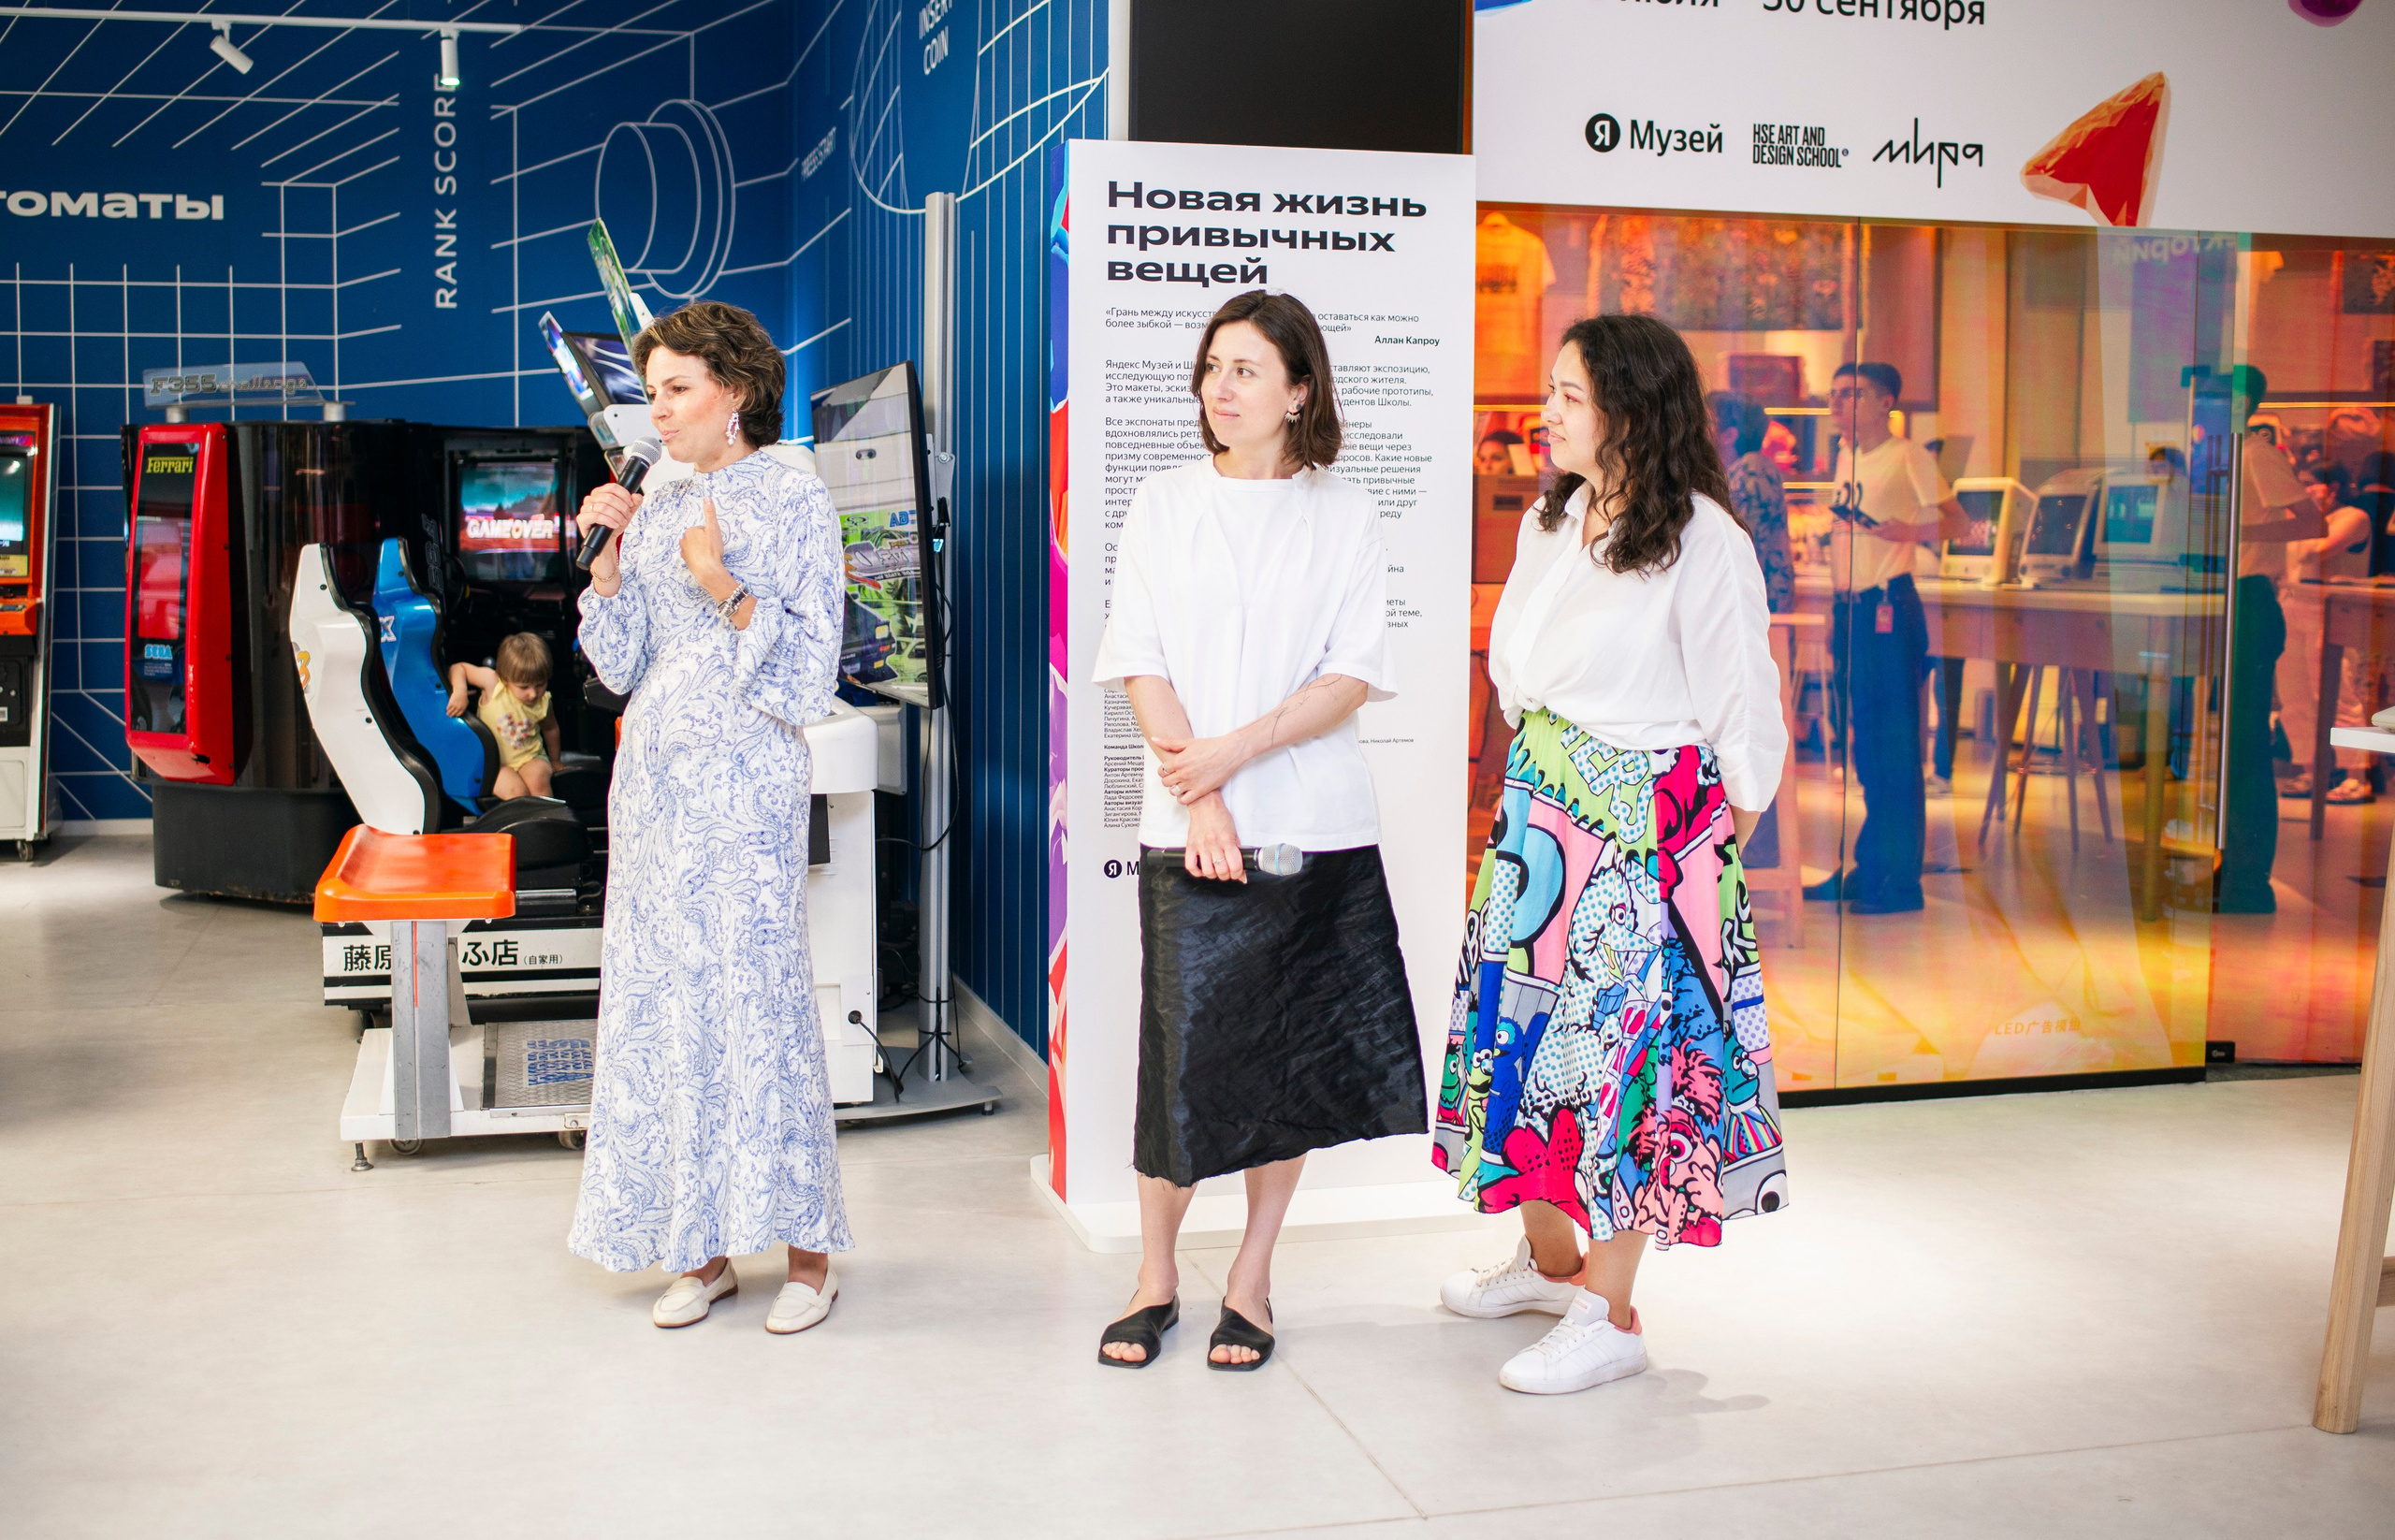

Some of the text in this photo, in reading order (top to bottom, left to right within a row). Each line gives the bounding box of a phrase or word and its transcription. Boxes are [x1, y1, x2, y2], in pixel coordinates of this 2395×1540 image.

[923, 25, 949, 75] COIN
[1630, 119, 1723, 157] Музей
[1753, 123, 1824, 147] HSE ART AND
[1753, 144, 1842, 168] DESIGN SCHOOL
[1108, 181, 1427, 217] Новая жизнь
[1108, 225, 1395, 253] привычных
[435, 209, 457, 309] RANK
[1108, 257, 1268, 288] вещей
[1106, 307, 1139, 318] «Грань
[1141, 309, 1173, 320] между
[1317, 312, 1369, 322] оставаться
[1387, 314, 1419, 323] можно
[1105, 319, 1135, 328] более
[1137, 318, 1172, 330] зыбкой
[1374, 336, 1440, 346] Аллан Капроу
[1106, 360, 1139, 370] Яндекс
[1142, 359, 1173, 370] Музей
[1372, 365, 1430, 374] экспозицию,
[149, 373, 217, 396] F355
[1106, 372, 1175, 382] исследующую
[1371, 376, 1406, 385] жителя.
[1106, 383, 1123, 391] Это
[1125, 385, 1163, 393] макеты,
[1342, 386, 1380, 396] рабочие
[1383, 387, 1433, 397] прототипы,
[1377, 398, 1412, 406] Школы.
[1106, 417, 1123, 426] Все
[1125, 419, 1175, 428] экспонаты
[1343, 432, 1403, 441] исследовали
[1105, 442, 1175, 450] повседневные
[146, 456, 194, 474] Ferrari
[1105, 454, 1142, 462] призму
[1374, 454, 1402, 462] Какие
[1105, 464, 1147, 473] функции
[1380, 466, 1421, 474] решения
[1105, 476, 1133, 485] могут
[1362, 477, 1415, 486] привычные
[1397, 499, 1417, 508] друг
[511, 518, 554, 540] OVER
[144, 644, 173, 660] SEGA
